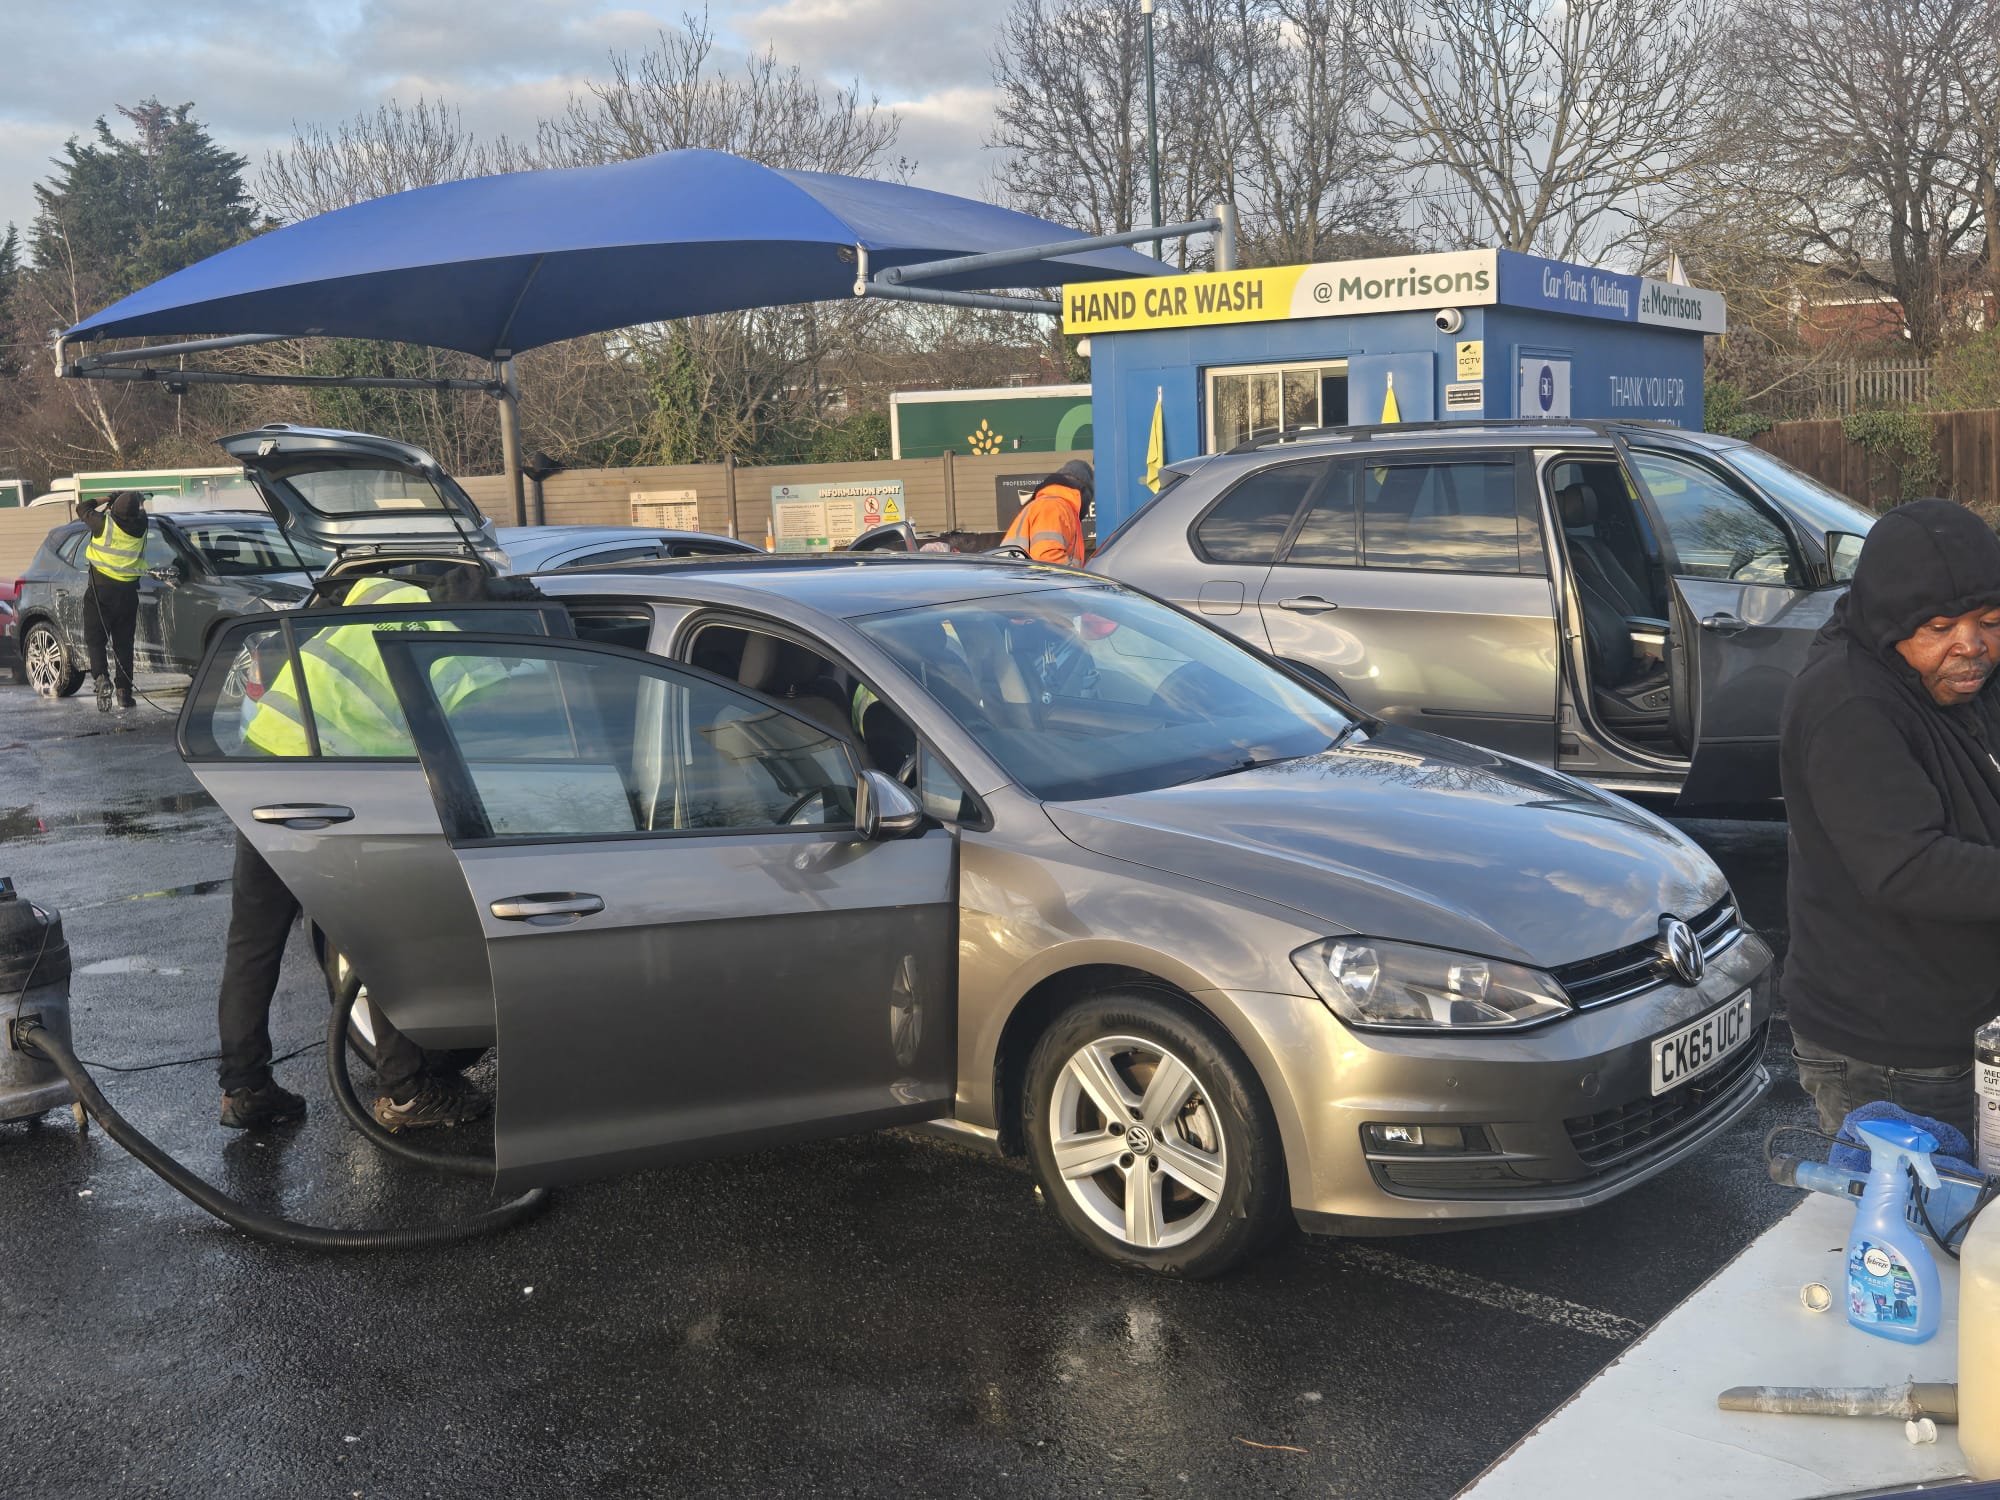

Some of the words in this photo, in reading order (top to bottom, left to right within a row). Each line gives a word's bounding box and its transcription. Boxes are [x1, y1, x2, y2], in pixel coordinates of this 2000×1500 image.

[1071, 290, 1137, 324] HAND
[1144, 286, 1187, 318] CAR
[1193, 279, 1263, 314] WASH
[1542, 266, 1561, 299] Car
[1563, 270, 1587, 304] Park
[1590, 275, 1629, 318] Valeting
[1641, 296, 1650, 314] at
[1651, 286, 1702, 321] Morrisons
[1459, 357, 1481, 365] CCTV
[1609, 375, 1644, 407] THANK
[1646, 376, 1665, 407] YOU
[1667, 378, 1684, 408] FOR
[819, 487, 876, 499] INFORMATION
[1661, 1021, 1713, 1083] CK65
[1717, 998, 1746, 1053] UCF
[1983, 1076, 1998, 1086] CUT
